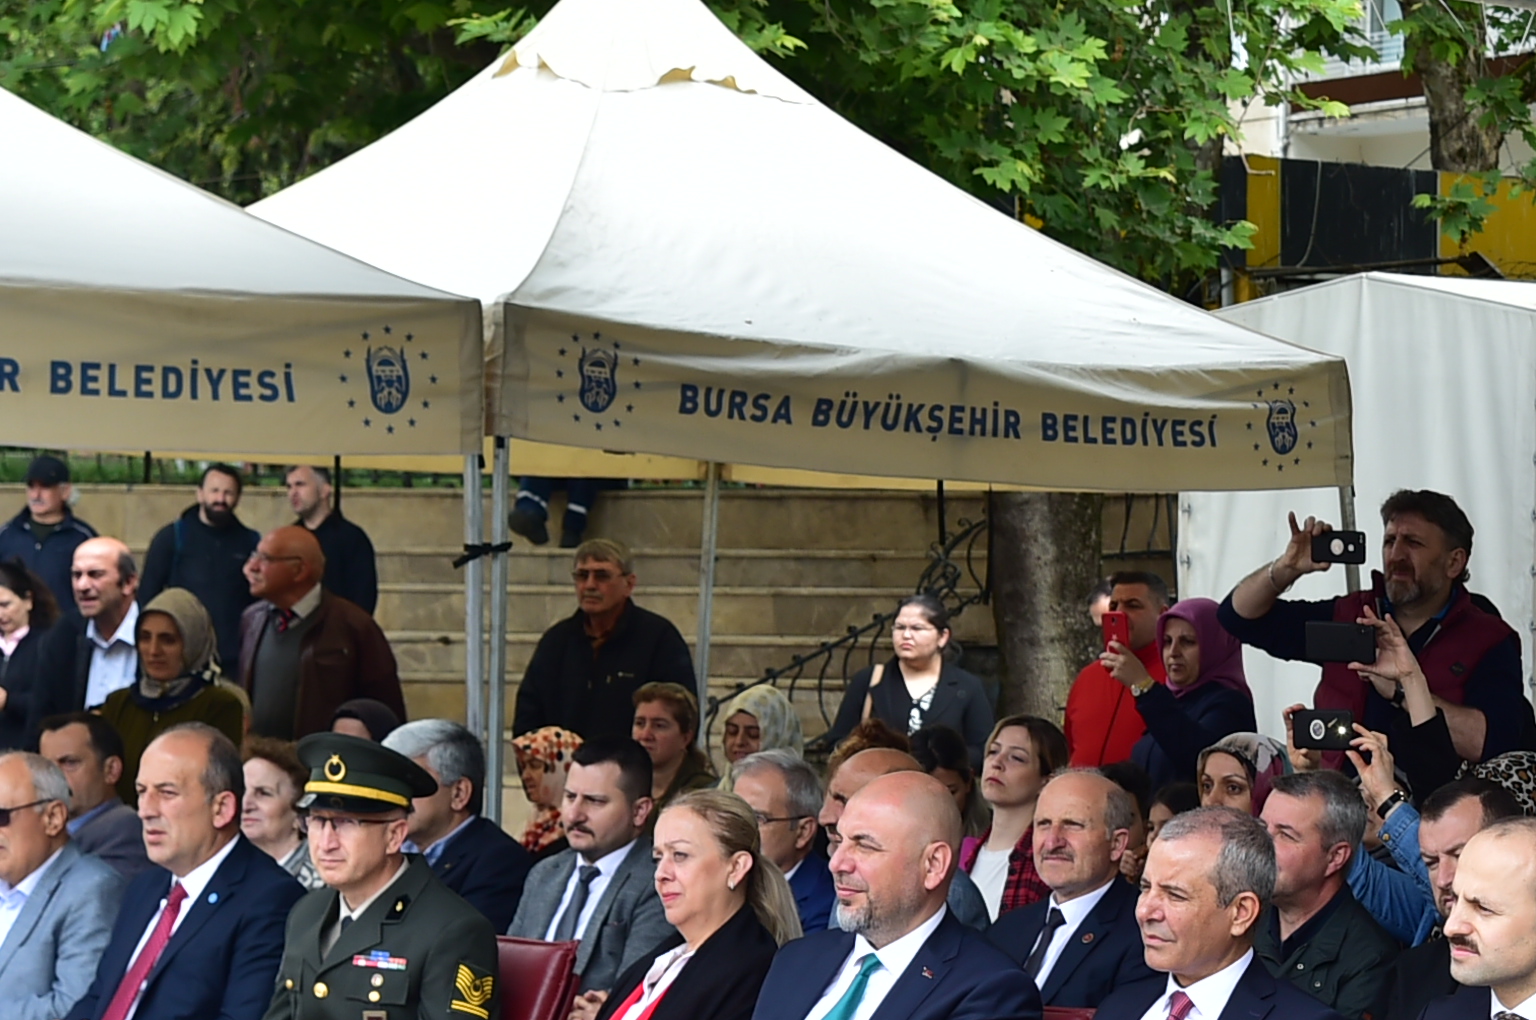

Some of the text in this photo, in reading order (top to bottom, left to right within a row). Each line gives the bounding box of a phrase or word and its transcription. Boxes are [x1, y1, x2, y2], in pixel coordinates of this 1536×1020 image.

[49, 359, 296, 403] BELEDİYESİ
[678, 383, 1218, 448] BURSA BÜYÜKŞEHİR BELEDİYESİ
